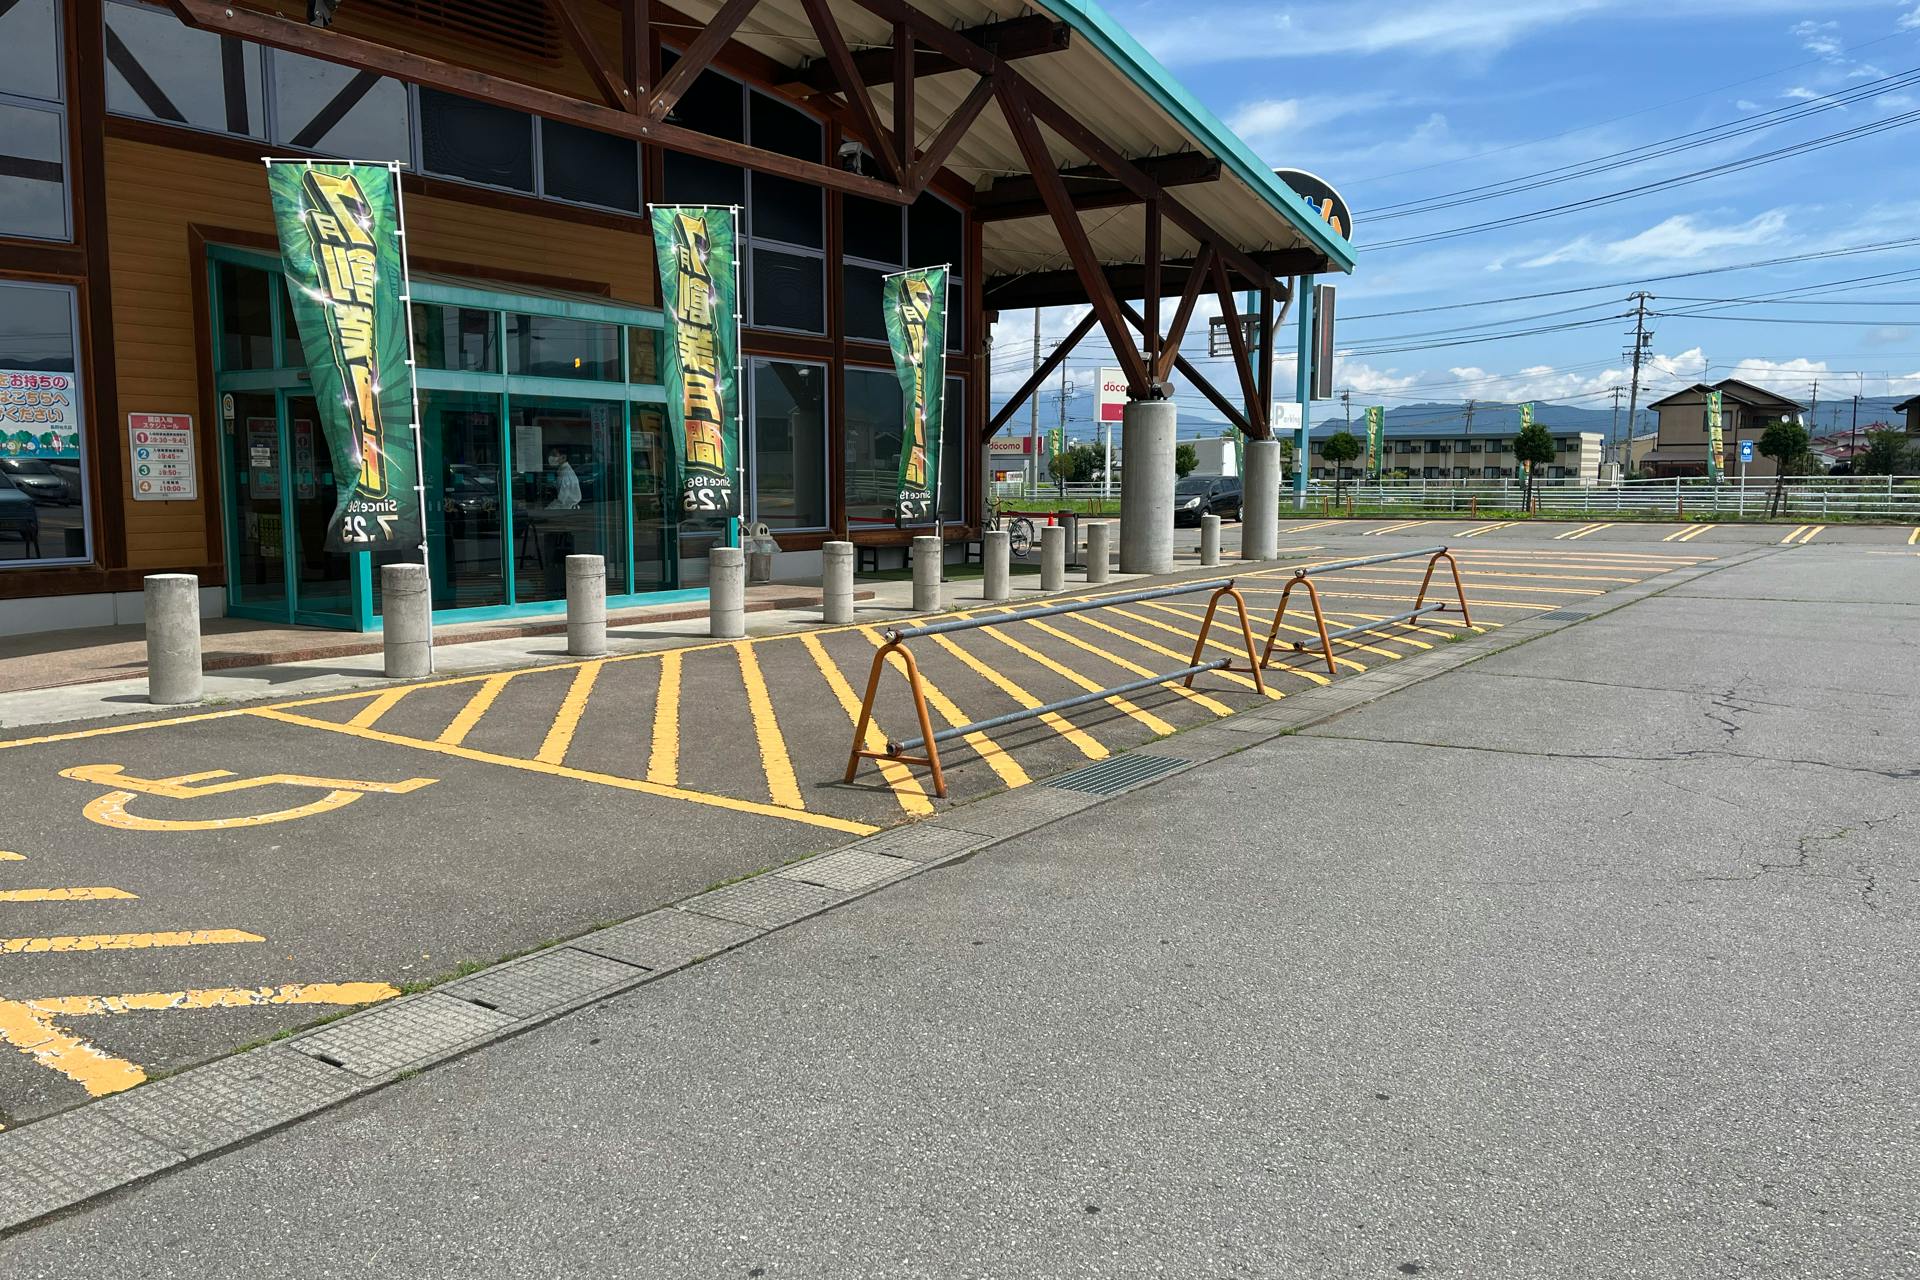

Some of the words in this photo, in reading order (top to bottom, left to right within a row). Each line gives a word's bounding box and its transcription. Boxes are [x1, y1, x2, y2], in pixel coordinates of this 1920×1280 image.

[0, 408, 63, 421] ください
[989, 441, 1020, 450] docomo
